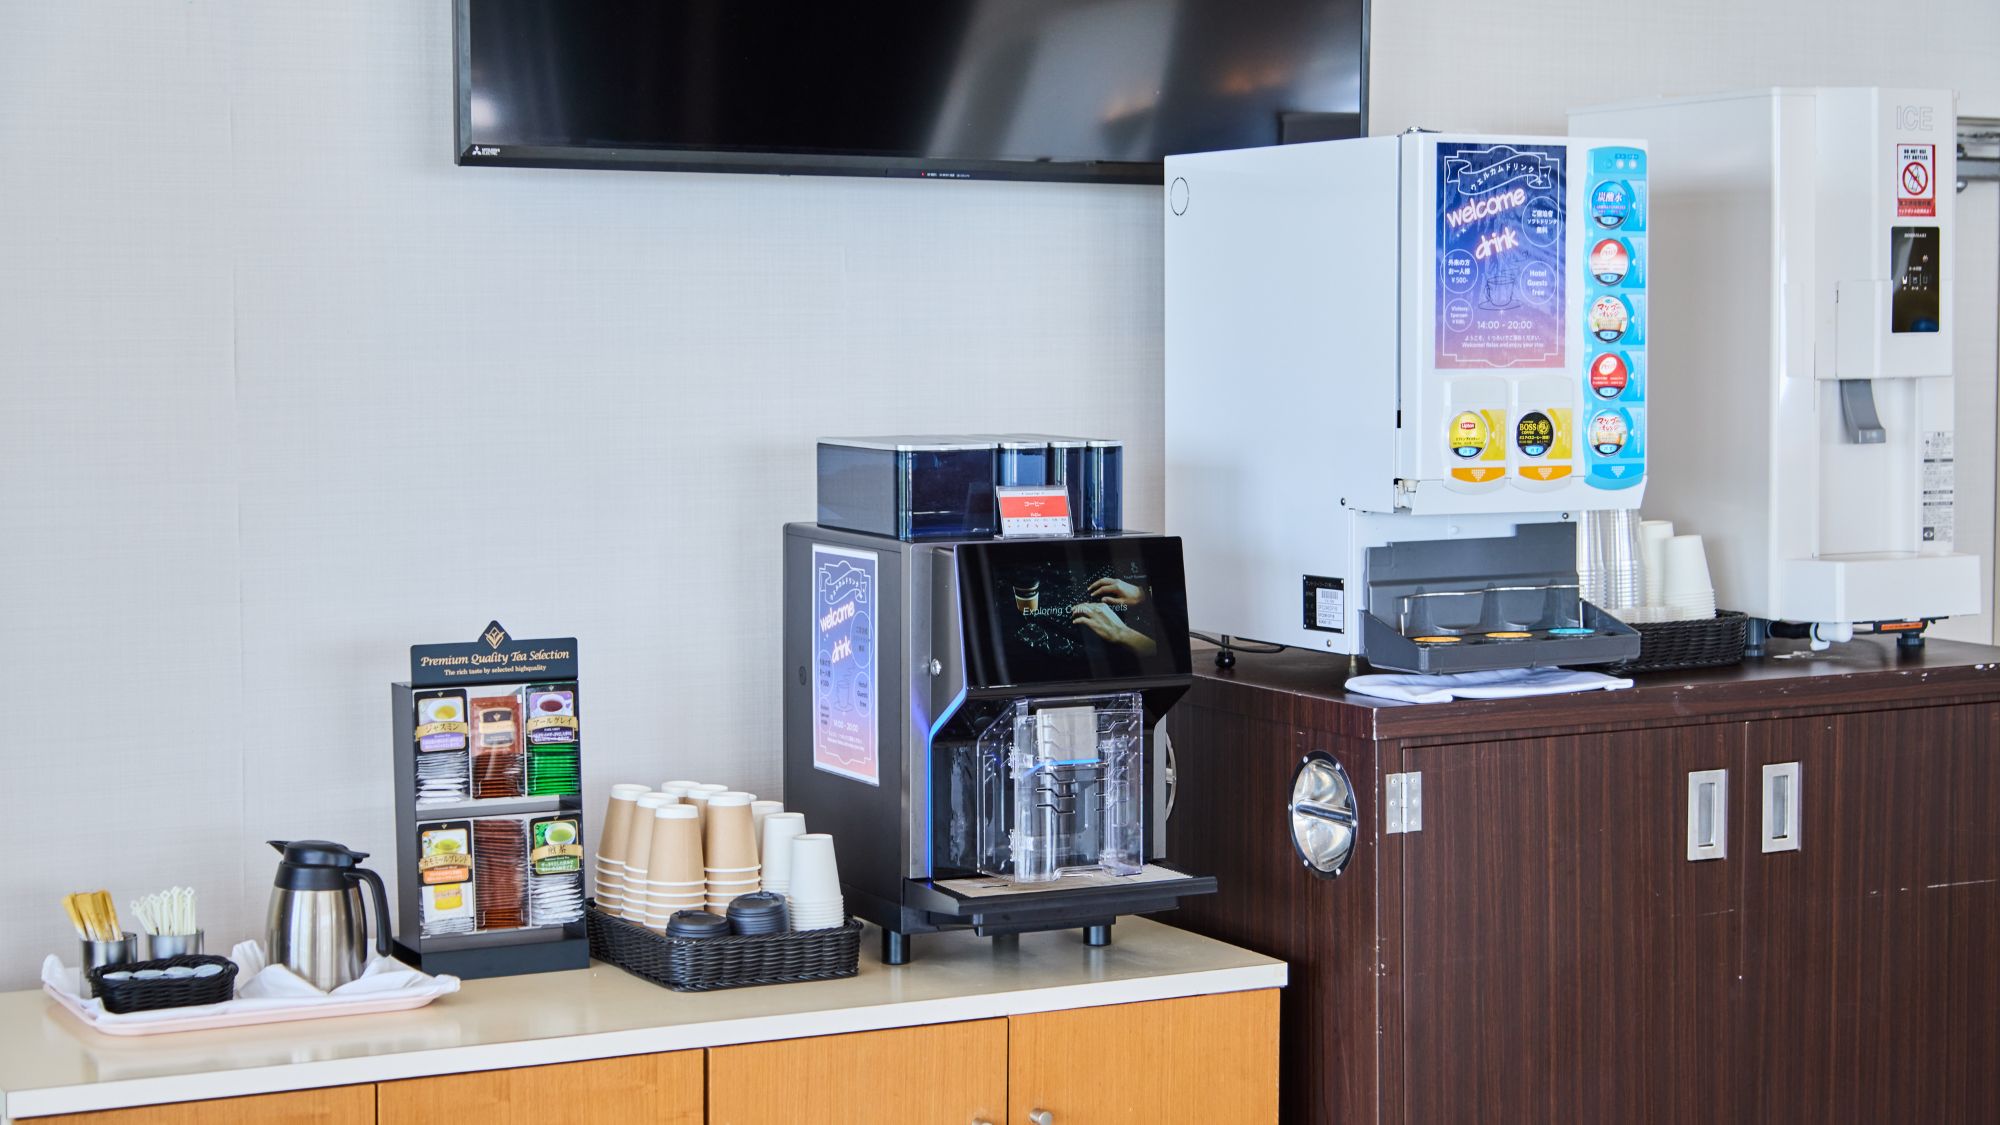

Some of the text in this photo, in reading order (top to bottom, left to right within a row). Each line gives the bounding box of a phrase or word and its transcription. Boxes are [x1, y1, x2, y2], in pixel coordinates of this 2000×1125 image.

[1896, 105, 1934, 131] ICE
[1470, 163, 1534, 191] ウェルカムドリンク
[1597, 191, 1623, 203] 炭酸水
[1446, 188, 1526, 228] welcome
[1475, 227, 1519, 260] drink
[1527, 279, 1548, 287] Guests
[1477, 321, 1500, 329] 14:00
[1507, 321, 1532, 329] 20:00
[1519, 423, 1537, 431] BOSS
[820, 600, 855, 633] welcome
[1022, 606, 1063, 617] Exploring
[831, 635, 852, 664] drink
[420, 649, 570, 667] Premium Quality Tea Selection
[491, 666, 515, 674] selected
[533, 716, 573, 727] アールグレイ
[425, 723, 460, 734] ジャスミン
[424, 856, 468, 867] カモミールブレンド
